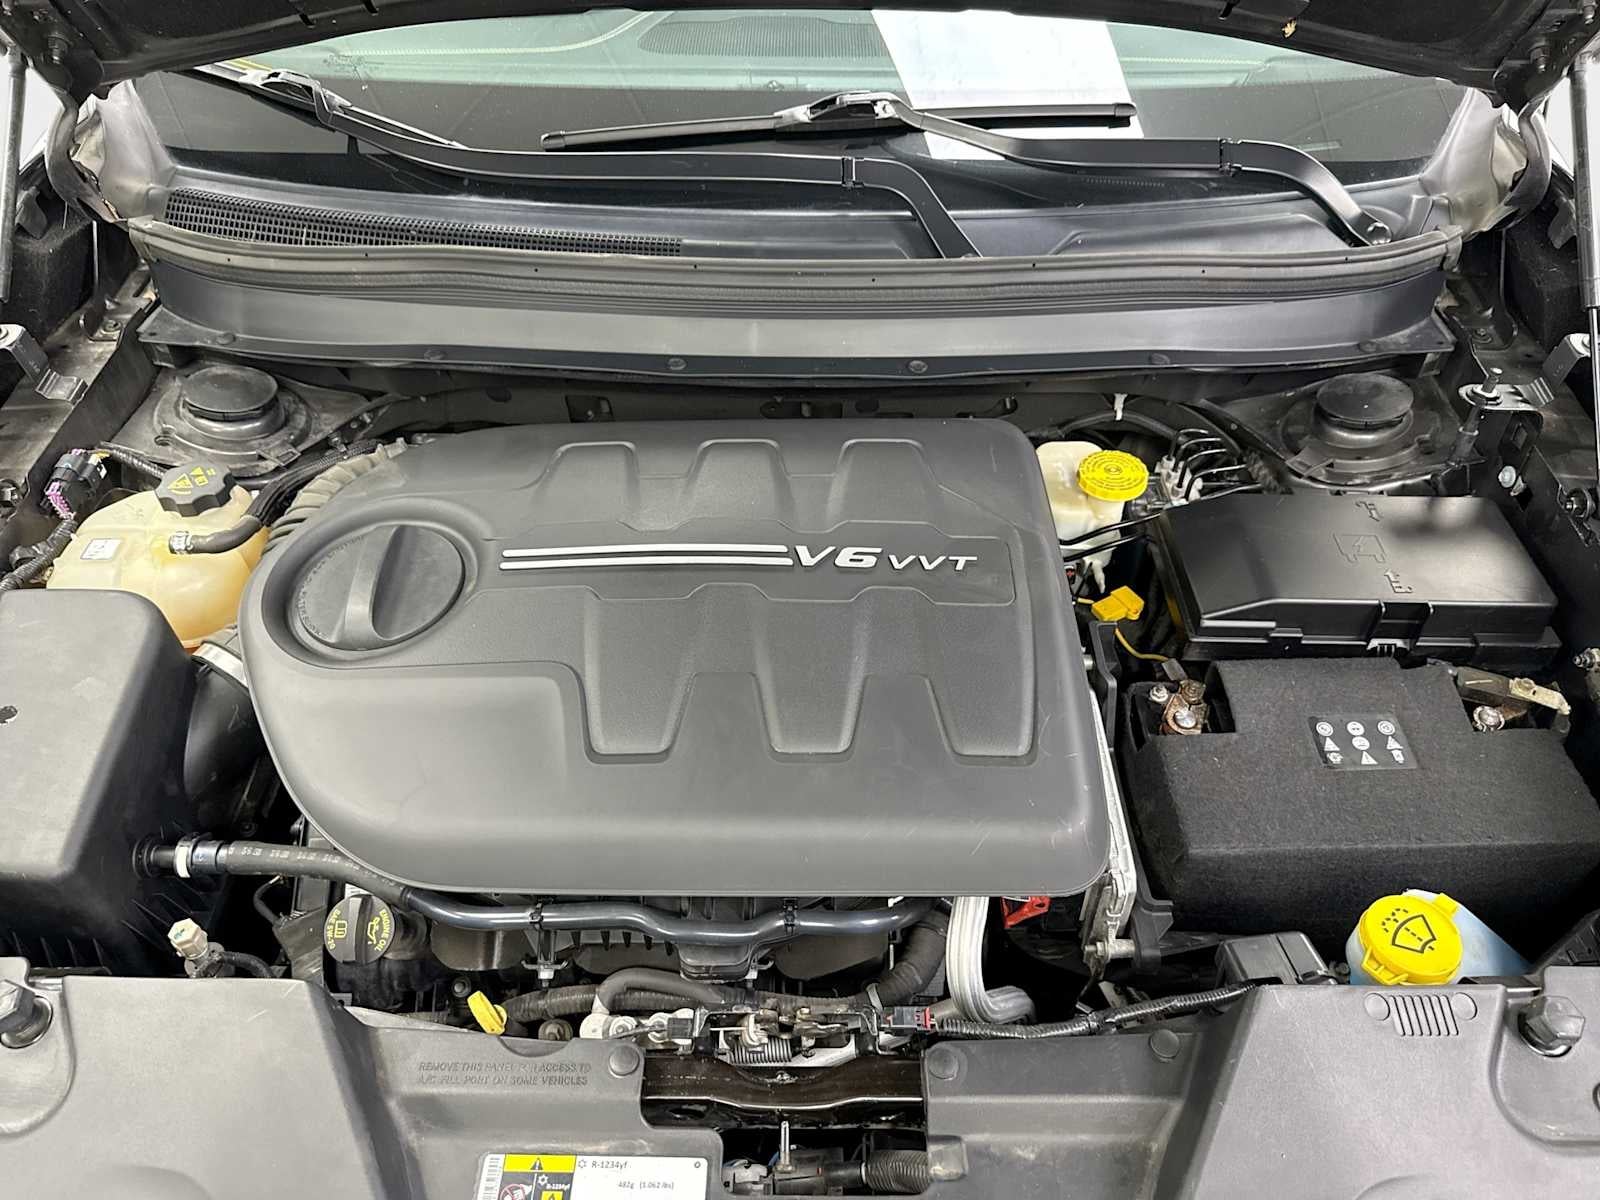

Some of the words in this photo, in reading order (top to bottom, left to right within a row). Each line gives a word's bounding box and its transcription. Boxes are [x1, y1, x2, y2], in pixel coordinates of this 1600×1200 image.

[795, 545, 883, 568] V6
[888, 554, 978, 571] VVT
[379, 909, 391, 938] ENGINE
[374, 939, 387, 952] OIL
[418, 1062, 460, 1072] REMOVE
[461, 1062, 482, 1072] THIS
[541, 1063, 577, 1073] ACCESS
[578, 1063, 592, 1073] TO
[510, 1076, 539, 1086] SOME
[541, 1076, 588, 1086] VEHICLES
